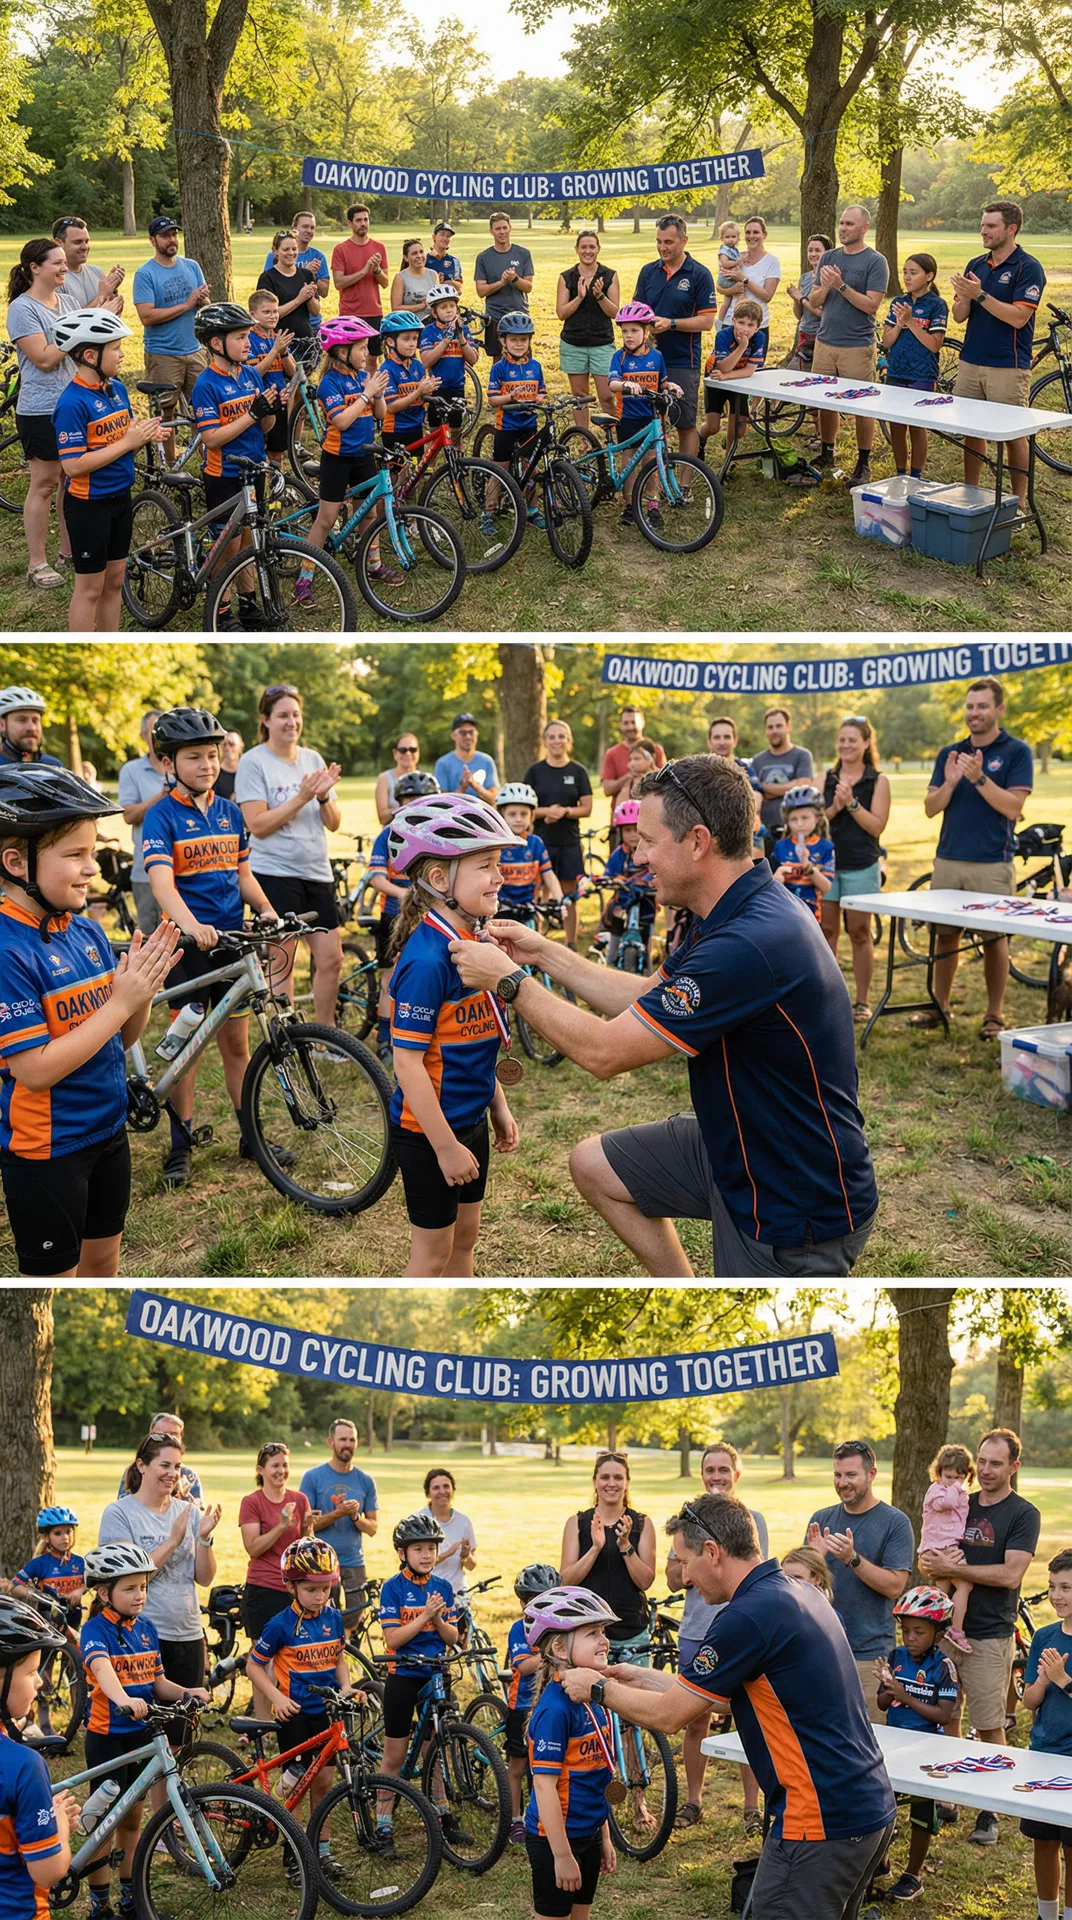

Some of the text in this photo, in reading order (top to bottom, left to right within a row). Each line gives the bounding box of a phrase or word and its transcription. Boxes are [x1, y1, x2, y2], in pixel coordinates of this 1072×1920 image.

[313, 154, 751, 199] OAKWOOD CYCLING CLUB: GROWING TOGETHER
[95, 415, 129, 437] OAKWO
[221, 399, 253, 417] OAKW
[607, 657, 699, 688] OAKWOOD
[703, 662, 788, 692] CYCLING
[793, 663, 854, 691] CLUB:
[862, 648, 972, 687] GROWING
[139, 1299, 827, 1399] OAKWOOD CYCLING CLUB: GROWING TOGETHER
